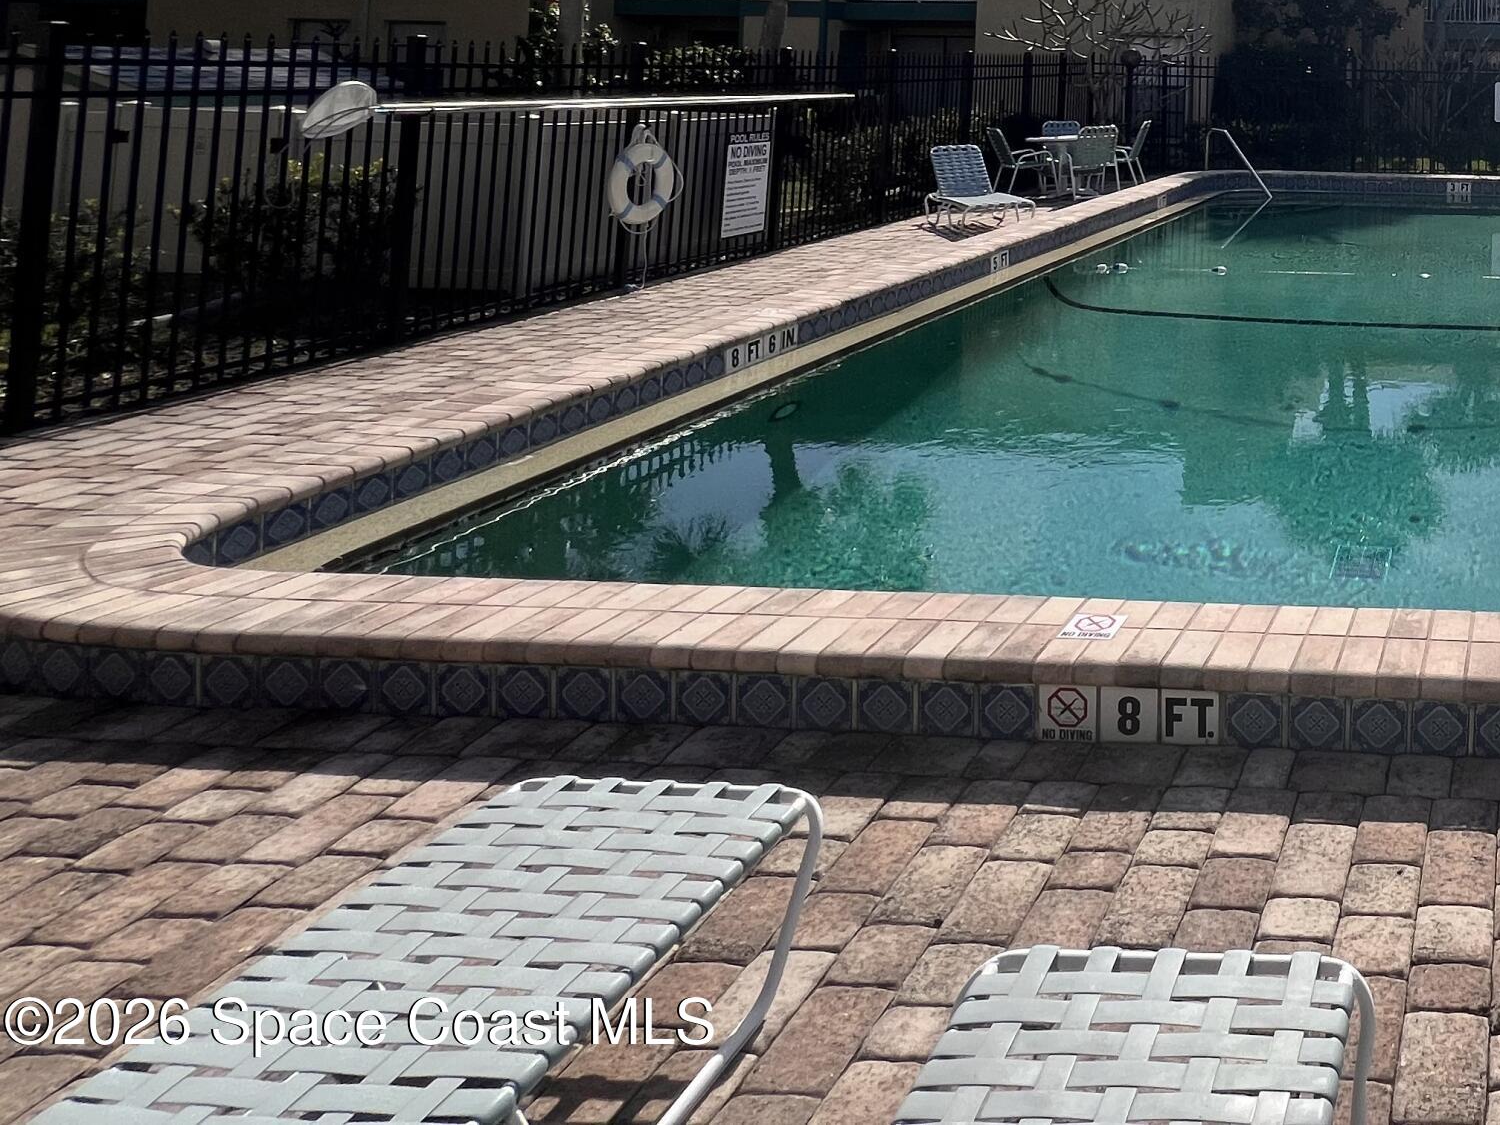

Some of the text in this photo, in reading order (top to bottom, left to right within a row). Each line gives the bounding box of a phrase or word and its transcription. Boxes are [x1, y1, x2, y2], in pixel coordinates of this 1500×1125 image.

[730, 132, 769, 143] POOL RULES
[730, 144, 767, 159] NO DIVING
[1461, 183, 1469, 191] FT
[993, 252, 1008, 270] 5 FT
[731, 348, 739, 368] 8
[748, 340, 760, 362] FT
[768, 335, 776, 353] 6
[1117, 696, 1214, 738] 8 FT.
[1042, 728, 1093, 741] NO DIVING
